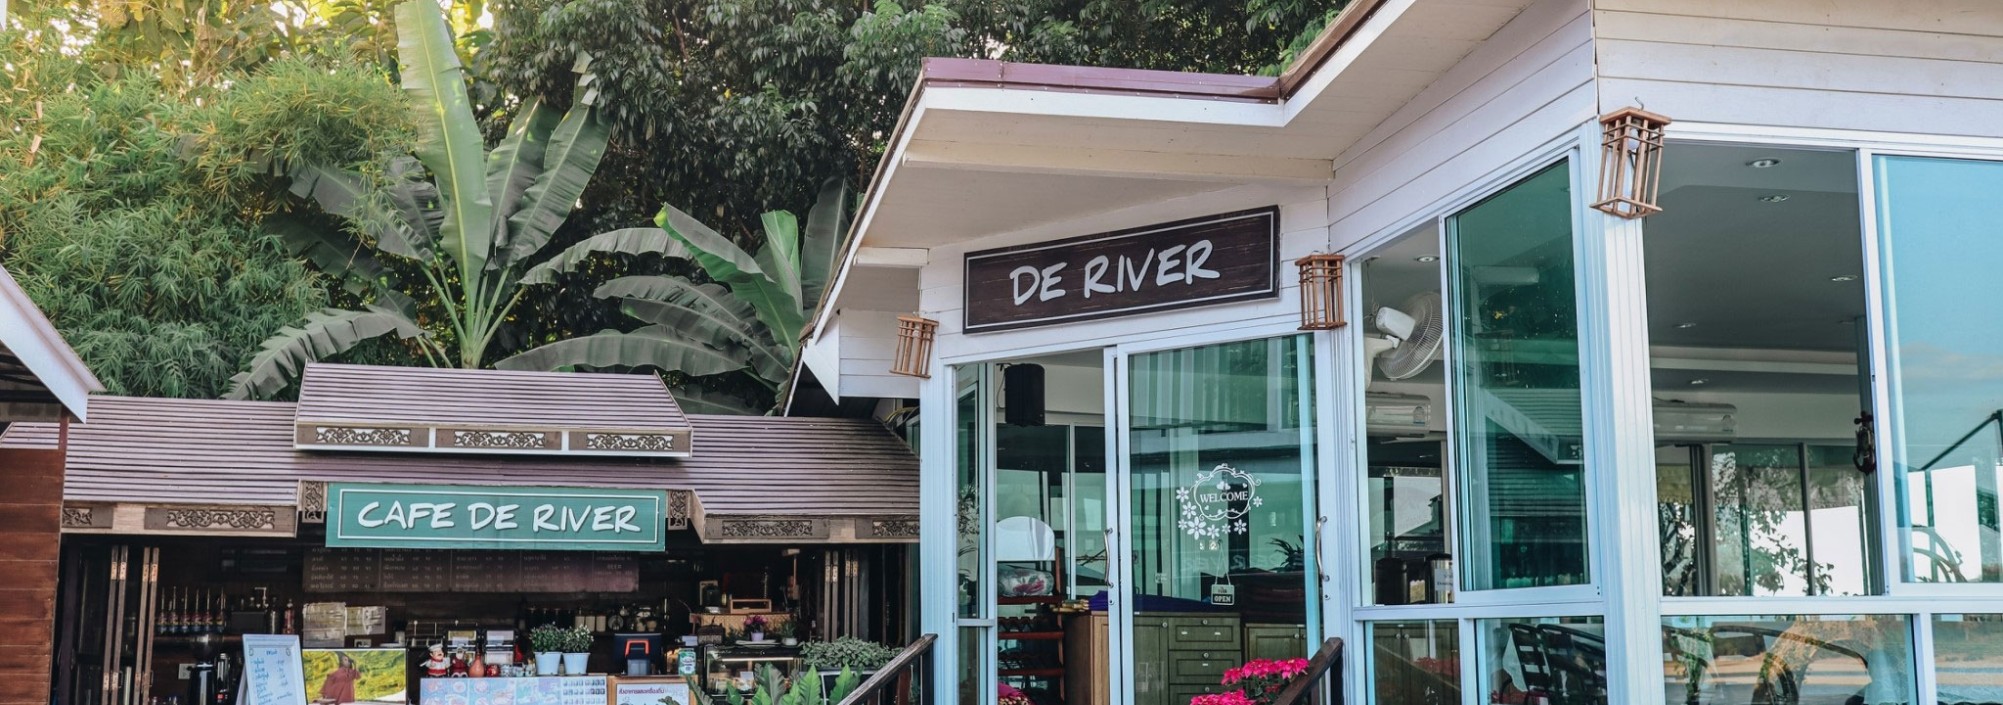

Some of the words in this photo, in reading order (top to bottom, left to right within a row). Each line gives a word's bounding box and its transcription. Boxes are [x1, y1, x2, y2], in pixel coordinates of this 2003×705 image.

[1009, 262, 1067, 306] DE
[1083, 239, 1221, 299] RIVER
[1199, 491, 1249, 503] WELCOME
[357, 500, 456, 530] CAFE
[467, 501, 520, 531] DE
[532, 503, 641, 534] RIVER
[1214, 595, 1232, 603] OPEN
